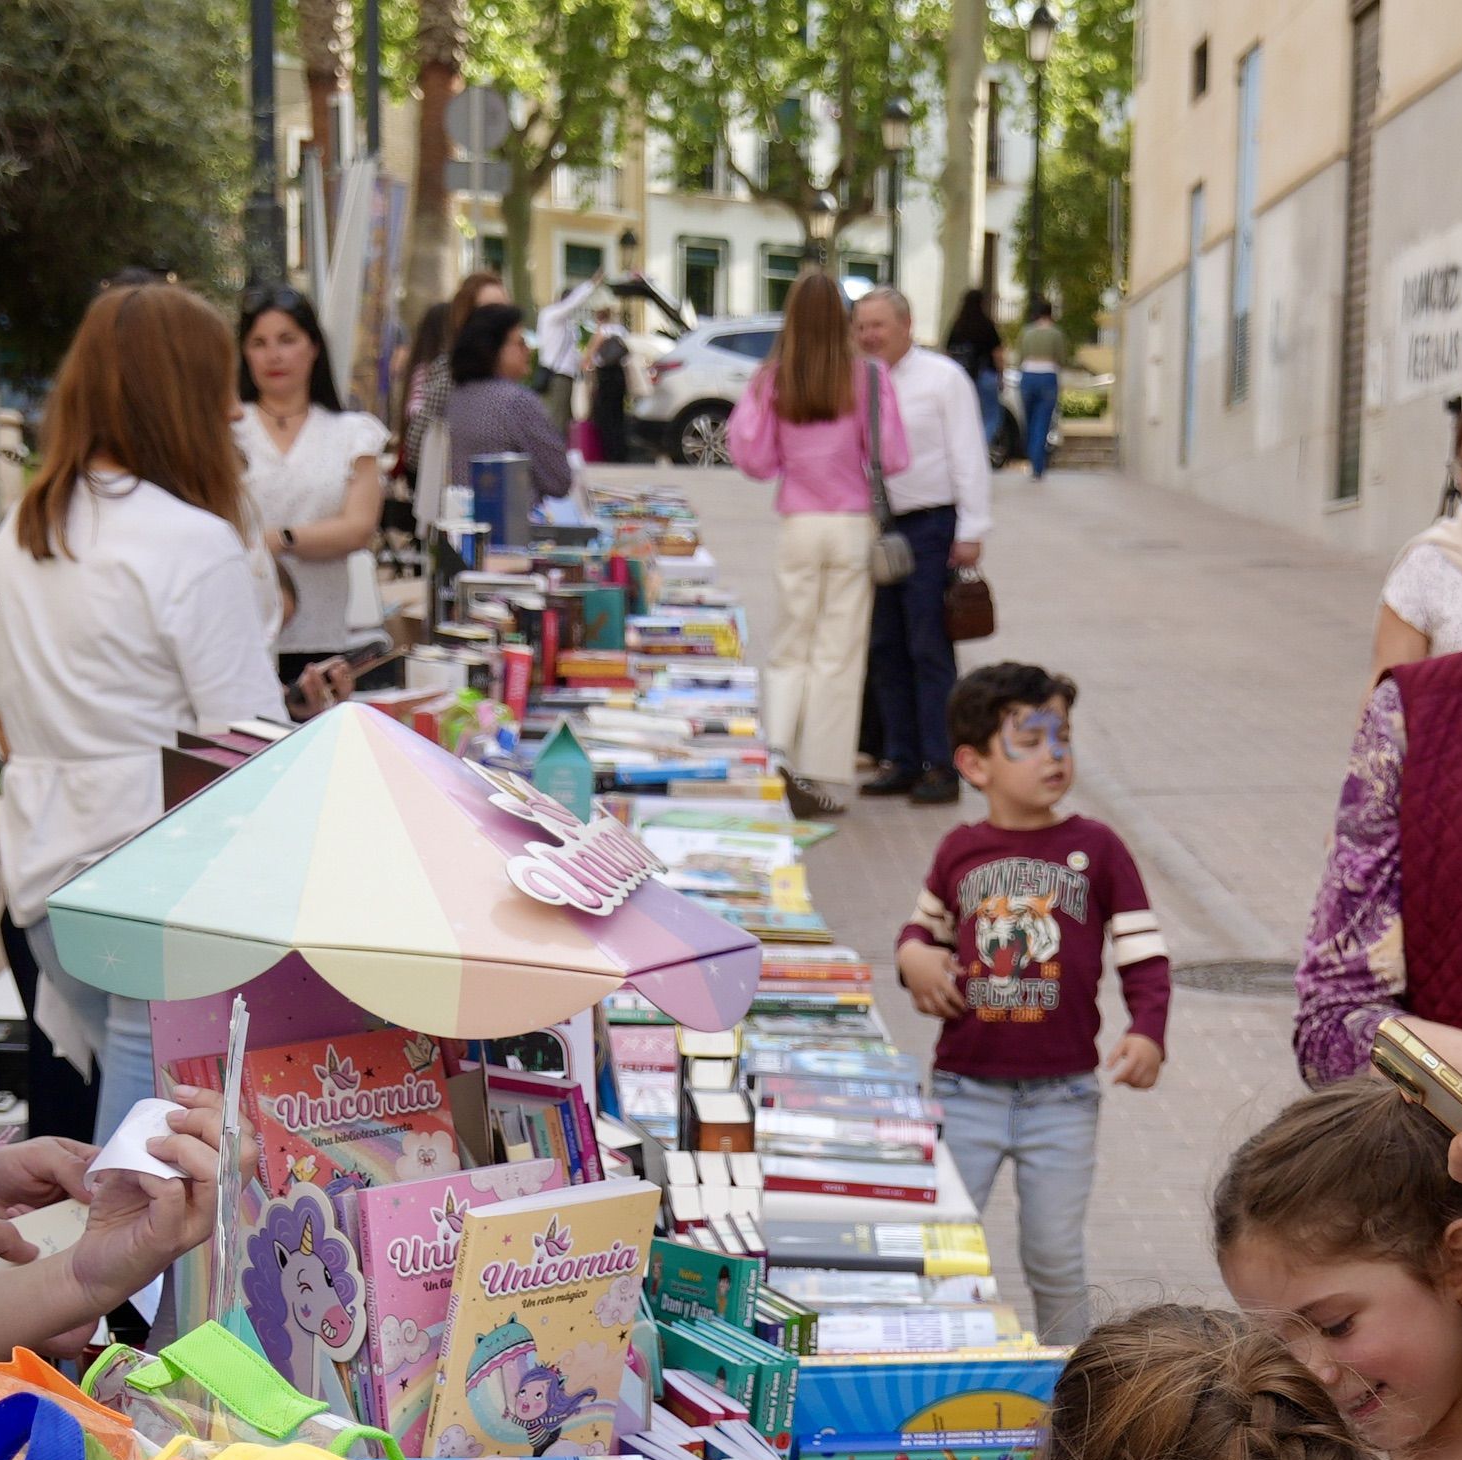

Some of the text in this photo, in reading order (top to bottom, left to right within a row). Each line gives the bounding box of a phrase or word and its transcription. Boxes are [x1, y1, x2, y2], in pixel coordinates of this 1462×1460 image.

[957, 856, 1090, 925] MINNESOTA
[966, 977, 1061, 1011] SPORTS
[277, 1074, 441, 1131] Unicornia
[312, 1121, 414, 1148] Una biblioteca secreta
[481, 1242, 638, 1295] Unicornia
[521, 1288, 589, 1309] Un reto mágico
